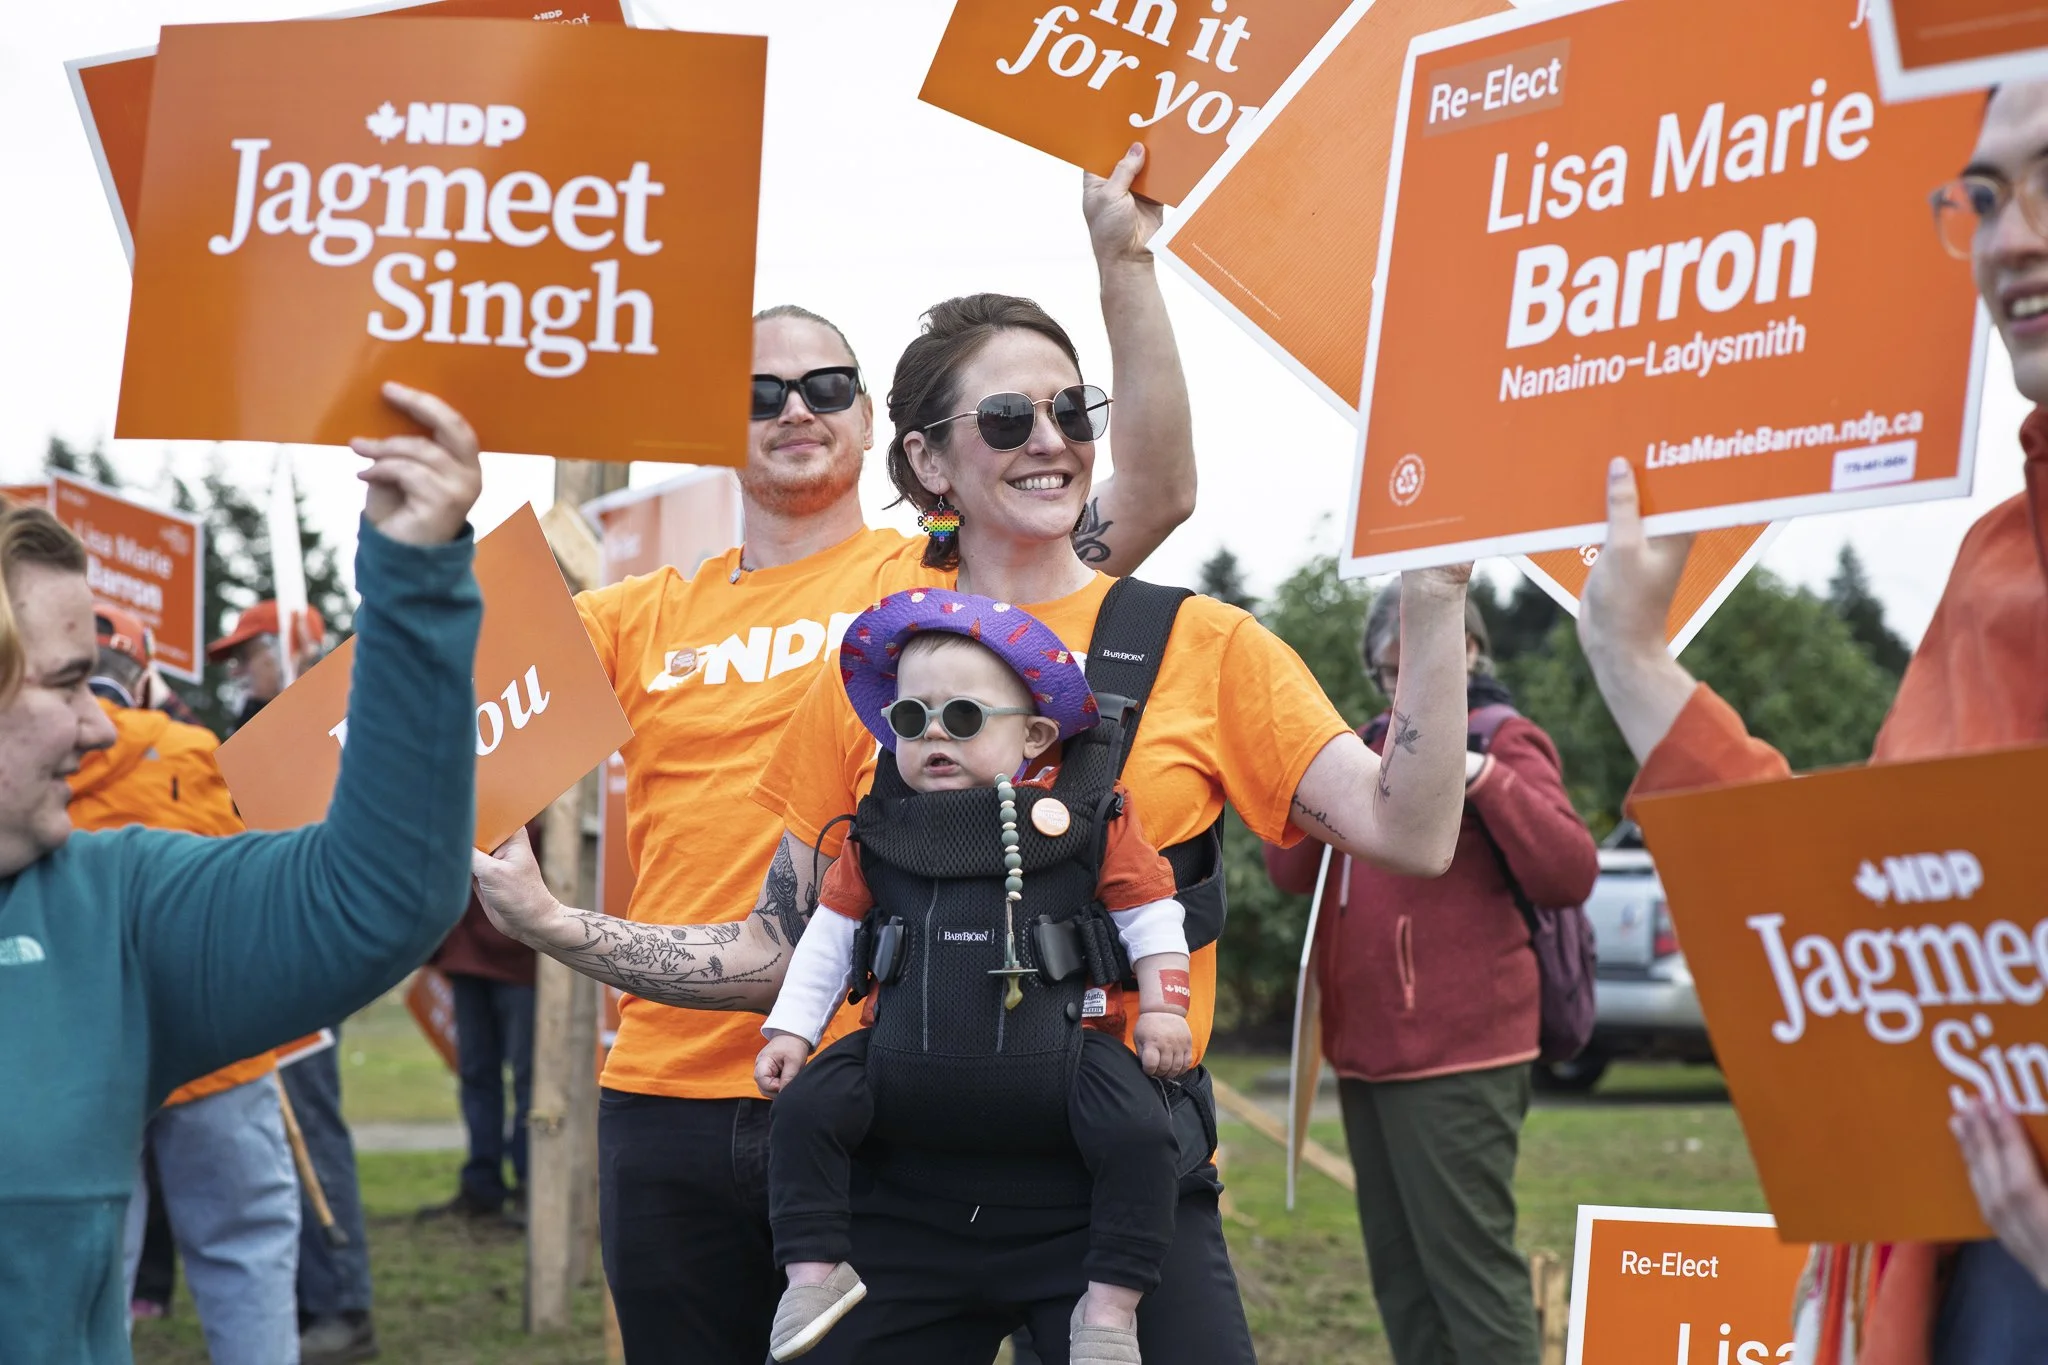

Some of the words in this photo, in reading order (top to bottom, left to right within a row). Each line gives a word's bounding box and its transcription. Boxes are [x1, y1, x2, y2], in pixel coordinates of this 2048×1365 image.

[540, 9, 563, 20] NDP
[996, 5, 1140, 91] for
[1186, 0, 1251, 73] it
[405, 102, 527, 148] NDP
[1428, 57, 1562, 125] Re-Elect
[1486, 141, 1628, 234] Lisa
[1650, 78, 1875, 199] Marie
[208, 138, 666, 268] Jagmeet
[366, 249, 659, 378] Singh
[1505, 217, 1818, 350] Barron
[1645, 410, 1925, 470] LisaMarieBarron.ndp.ca
[1884, 851, 1984, 903] NDP
[1621, 1250, 1719, 1278] Re-Elect
